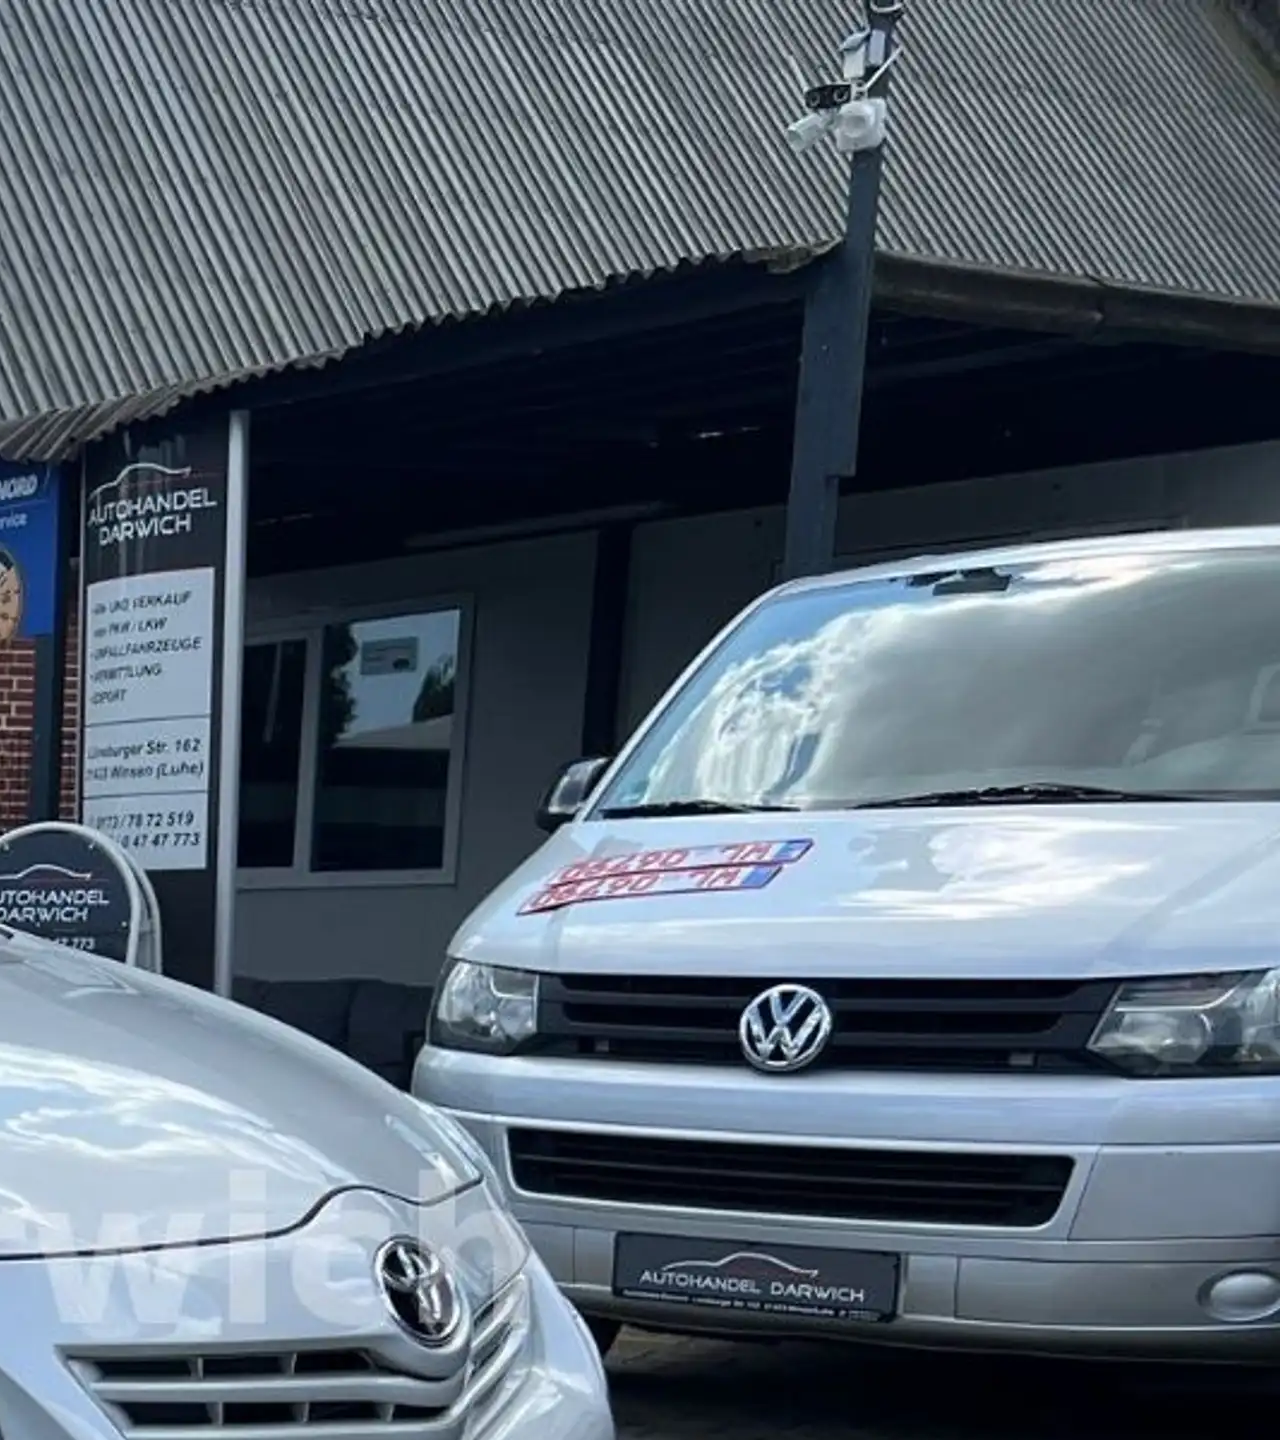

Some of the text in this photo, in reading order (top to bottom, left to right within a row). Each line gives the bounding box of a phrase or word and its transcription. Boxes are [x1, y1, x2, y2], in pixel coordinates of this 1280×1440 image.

[89, 488, 217, 526] AUTOHANDEL
[98, 513, 192, 546] DARWICH
[175, 738, 201, 753] 162
[146, 812, 163, 827] 72
[167, 809, 194, 827] 519
[151, 832, 170, 847] 47
[173, 832, 201, 846] 773
[639, 1269, 865, 1304] AUTOHANDEL DARWICH
